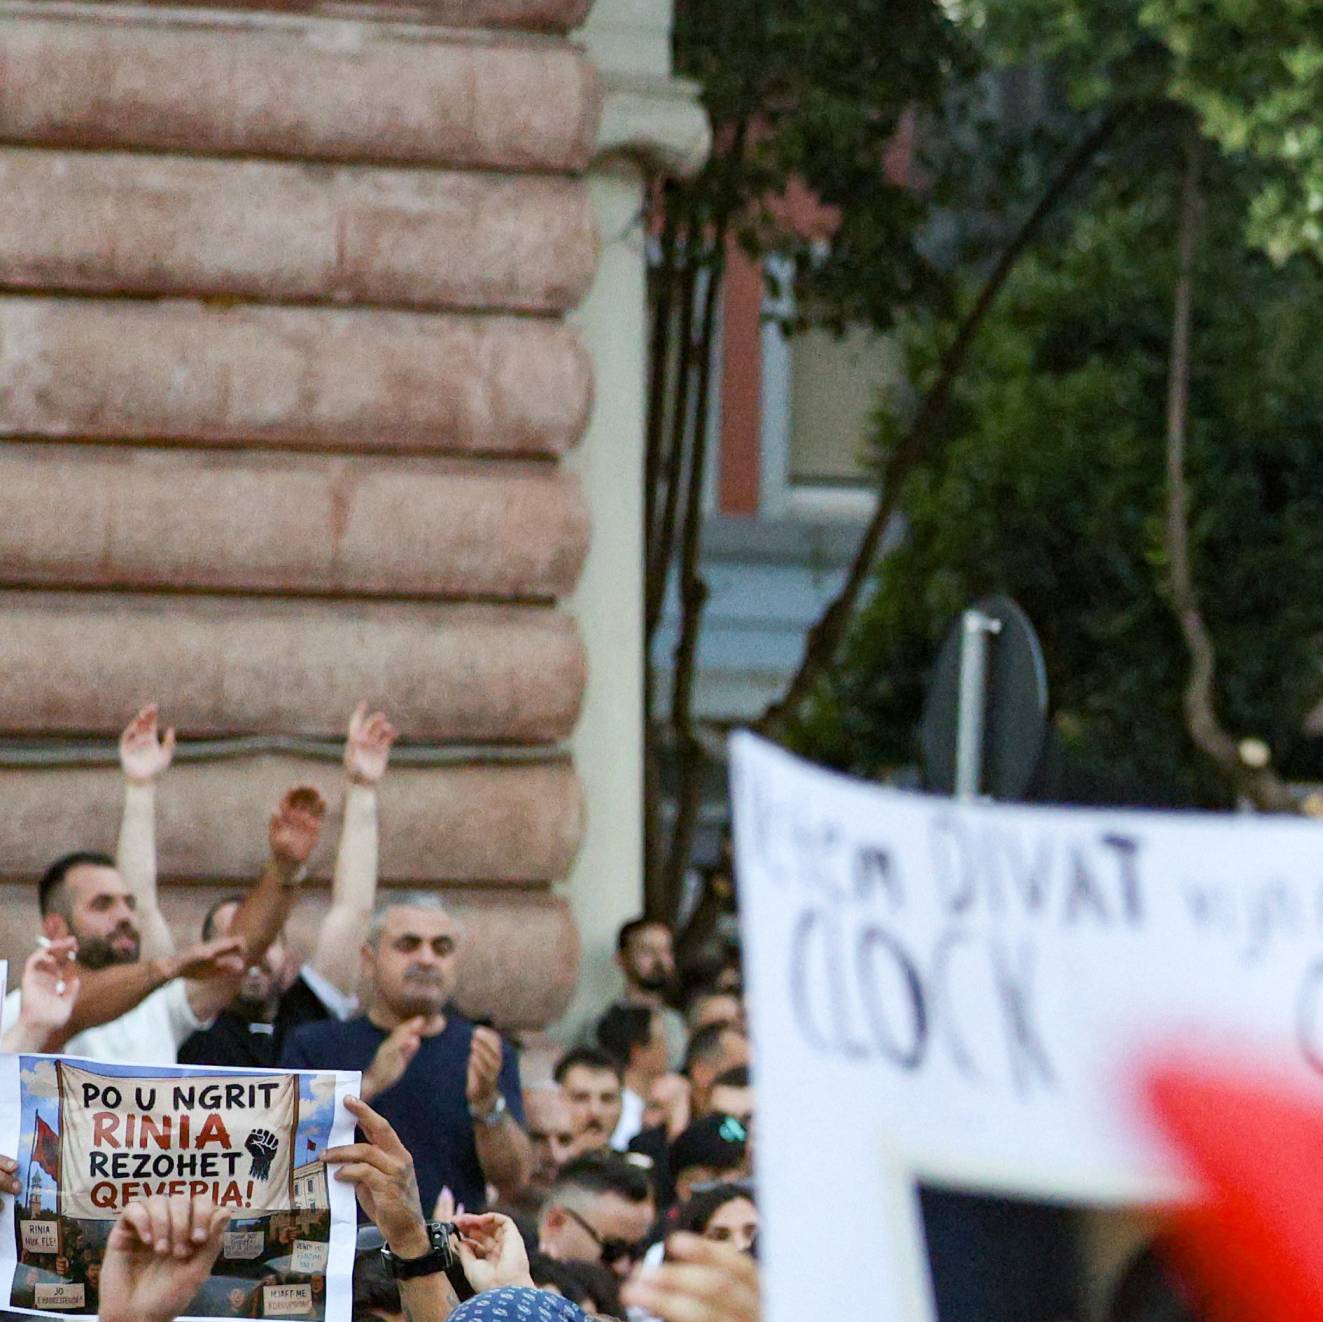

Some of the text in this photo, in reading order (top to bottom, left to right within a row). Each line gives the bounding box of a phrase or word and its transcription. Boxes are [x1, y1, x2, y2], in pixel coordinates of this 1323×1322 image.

[82, 1082, 280, 1111] PO U NGRIT
[92, 1112, 233, 1150] RINIA
[89, 1151, 243, 1179] REZOHET
[29, 1224, 51, 1235] RINIA
